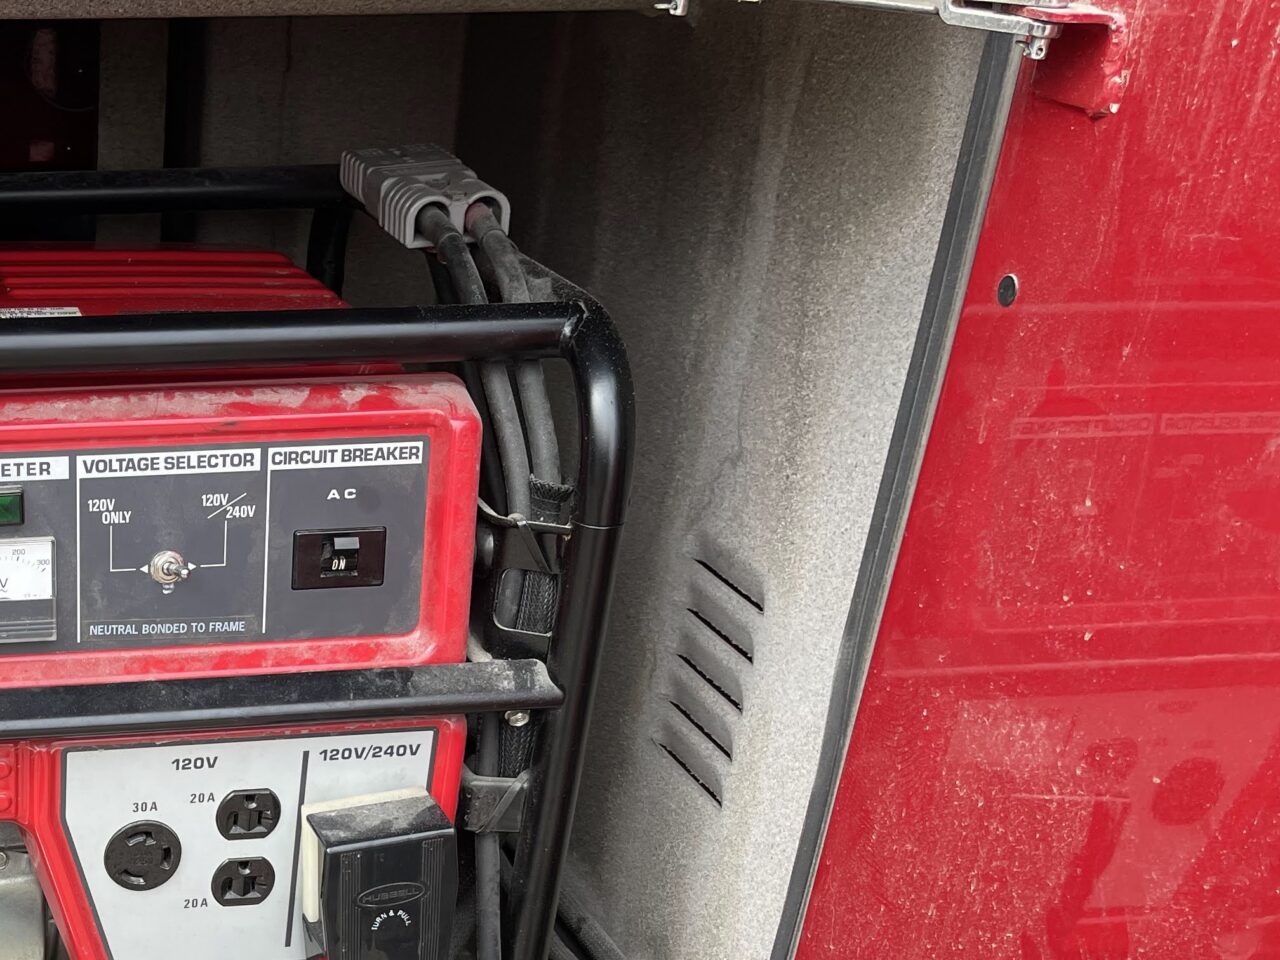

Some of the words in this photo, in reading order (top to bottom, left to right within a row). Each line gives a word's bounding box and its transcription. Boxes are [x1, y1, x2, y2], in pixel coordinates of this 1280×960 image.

[272, 449, 338, 466] CIRCUIT
[341, 446, 420, 463] BREAKER
[83, 457, 160, 474] VOLTAGE
[164, 453, 254, 470] SELECTOR
[88, 499, 115, 512] 120V
[102, 511, 131, 524] ONLY
[332, 559, 346, 570] ON
[90, 624, 138, 635] NEUTRAL
[142, 623, 187, 634] BONDED
[191, 623, 205, 632] TO
[209, 621, 245, 632] FRAME
[320, 744, 420, 761] 120V/240V
[171, 757, 218, 770] 120V
[371, 912, 387, 930] TURN
[397, 910, 411, 926] PULL
